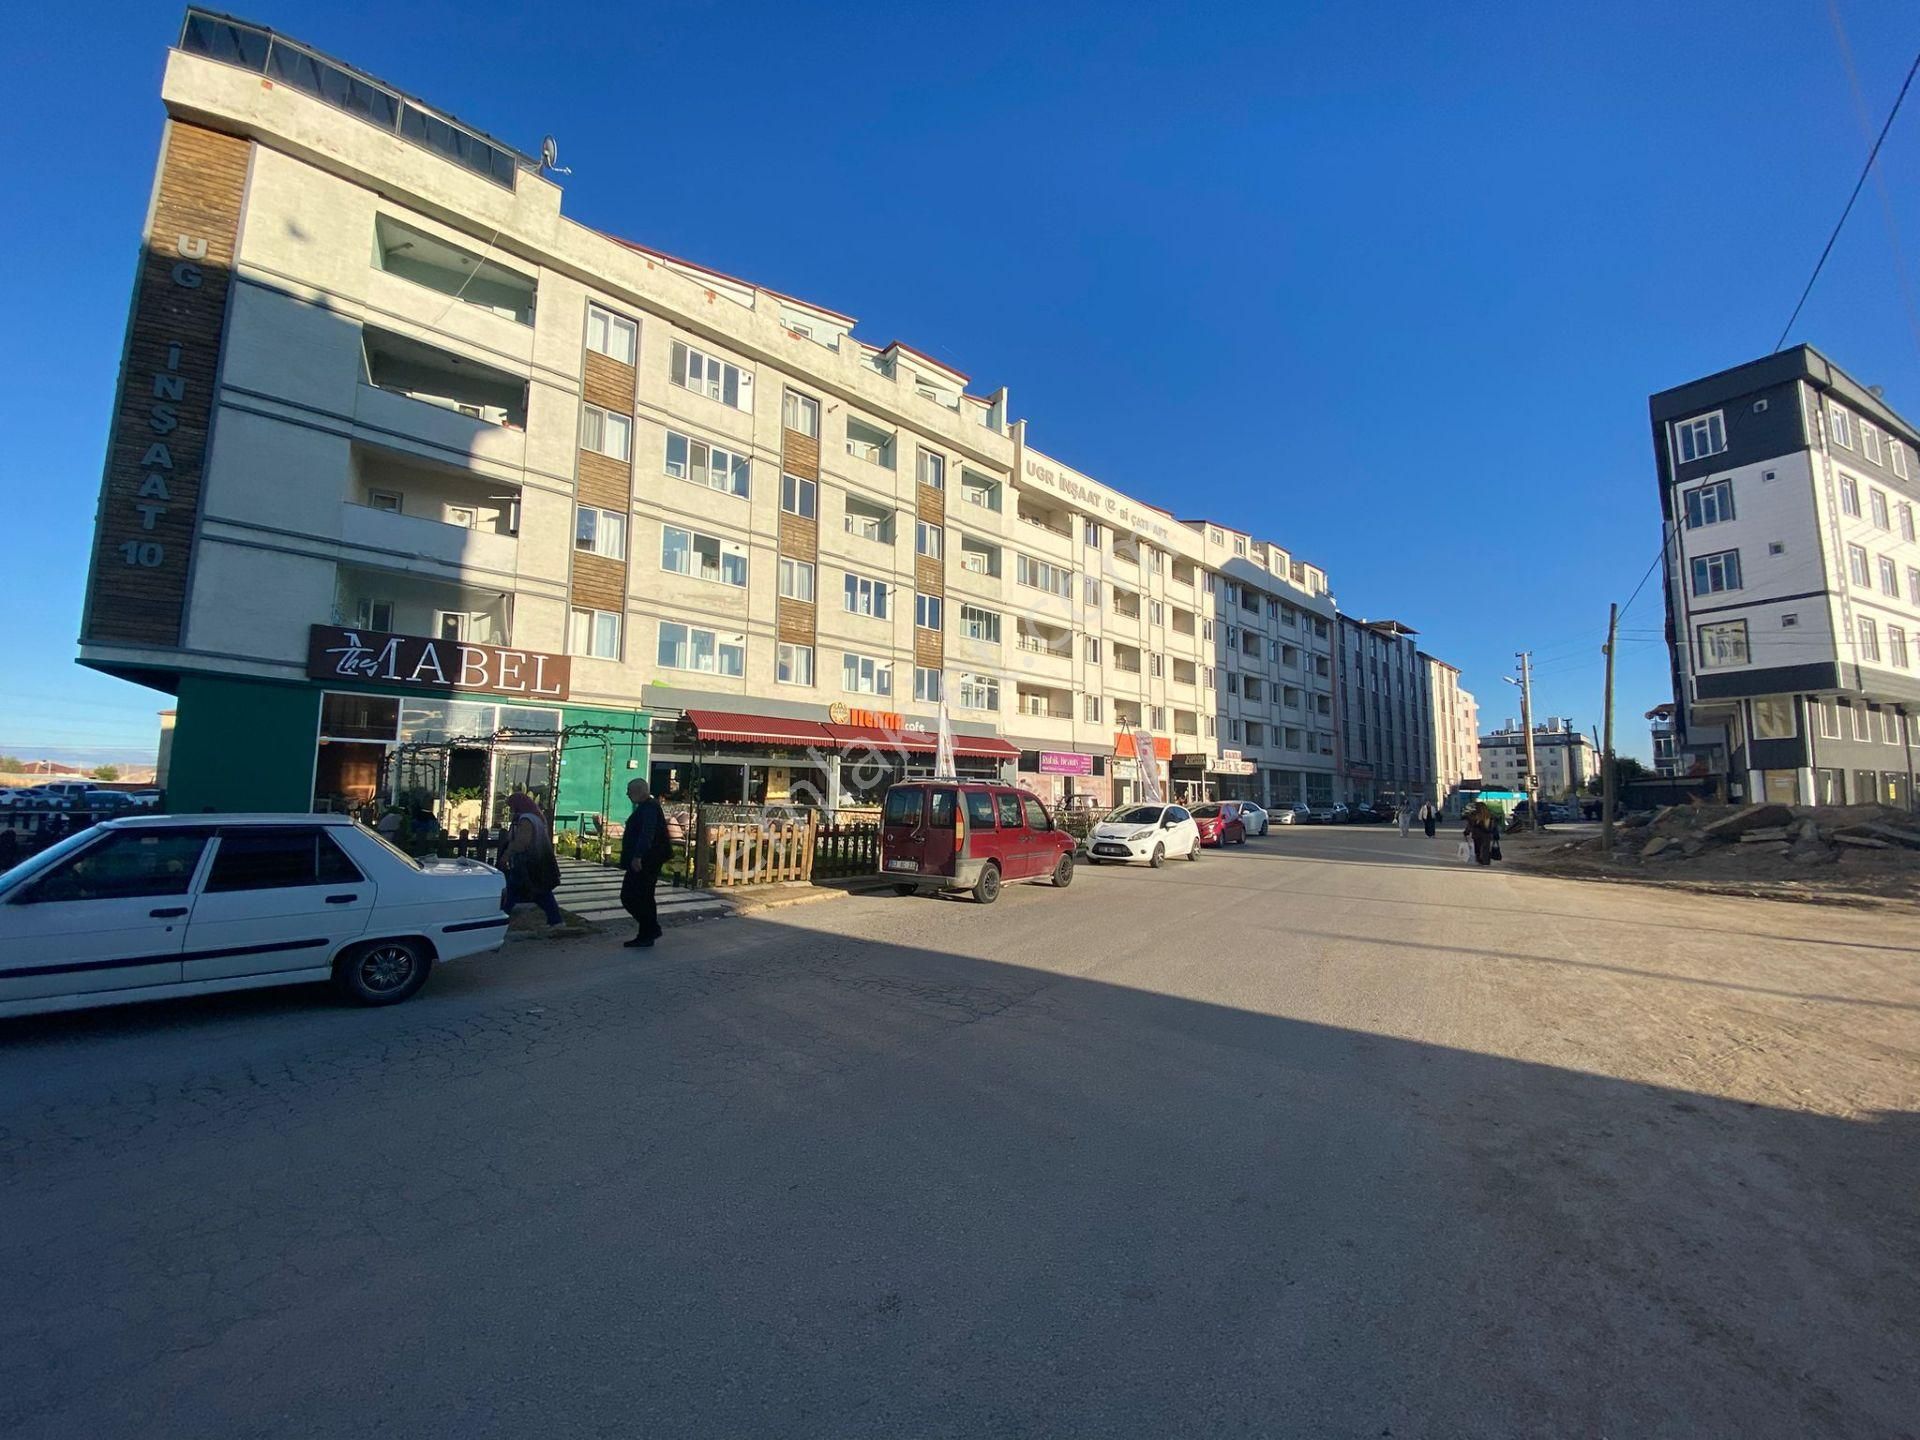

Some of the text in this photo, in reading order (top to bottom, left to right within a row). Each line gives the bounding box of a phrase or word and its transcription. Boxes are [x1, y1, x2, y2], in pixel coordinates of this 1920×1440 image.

[139, 339, 185, 530] İNŞAAT
[1026, 460, 1055, 487] UGR
[1059, 472, 1101, 508] İNŞAAT
[119, 541, 164, 569] 10
[344, 632, 561, 695] MABEL
